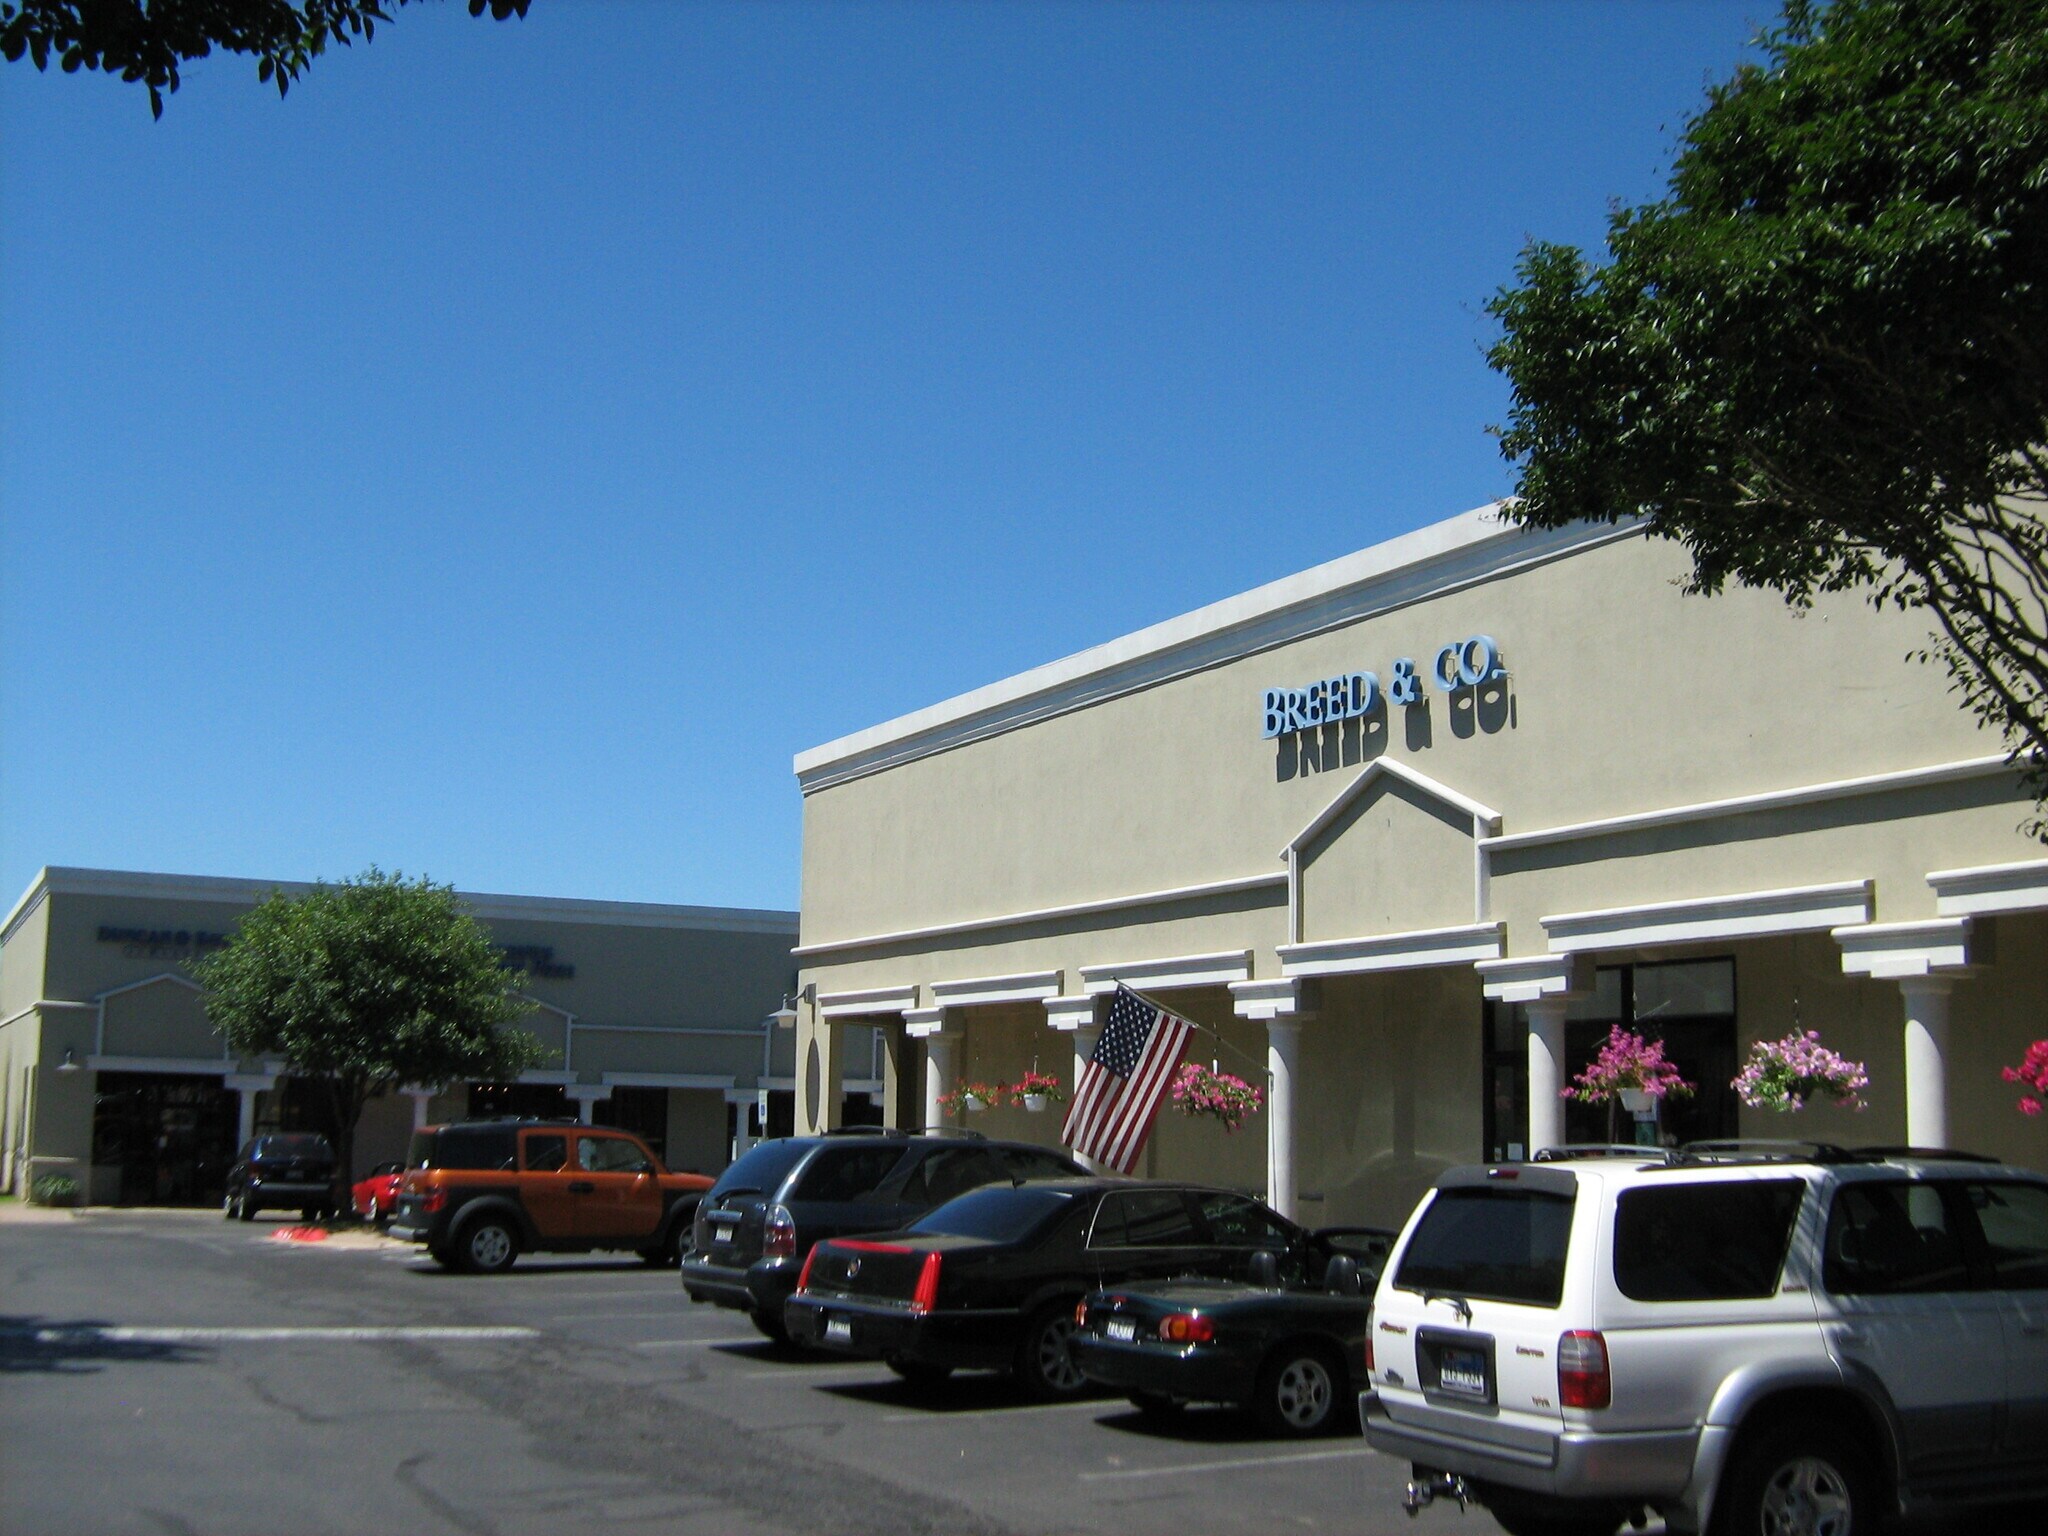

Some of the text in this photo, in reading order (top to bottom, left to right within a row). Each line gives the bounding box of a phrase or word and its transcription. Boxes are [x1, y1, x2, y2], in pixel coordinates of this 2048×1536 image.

[1261, 634, 1507, 739] BREED & CO.
